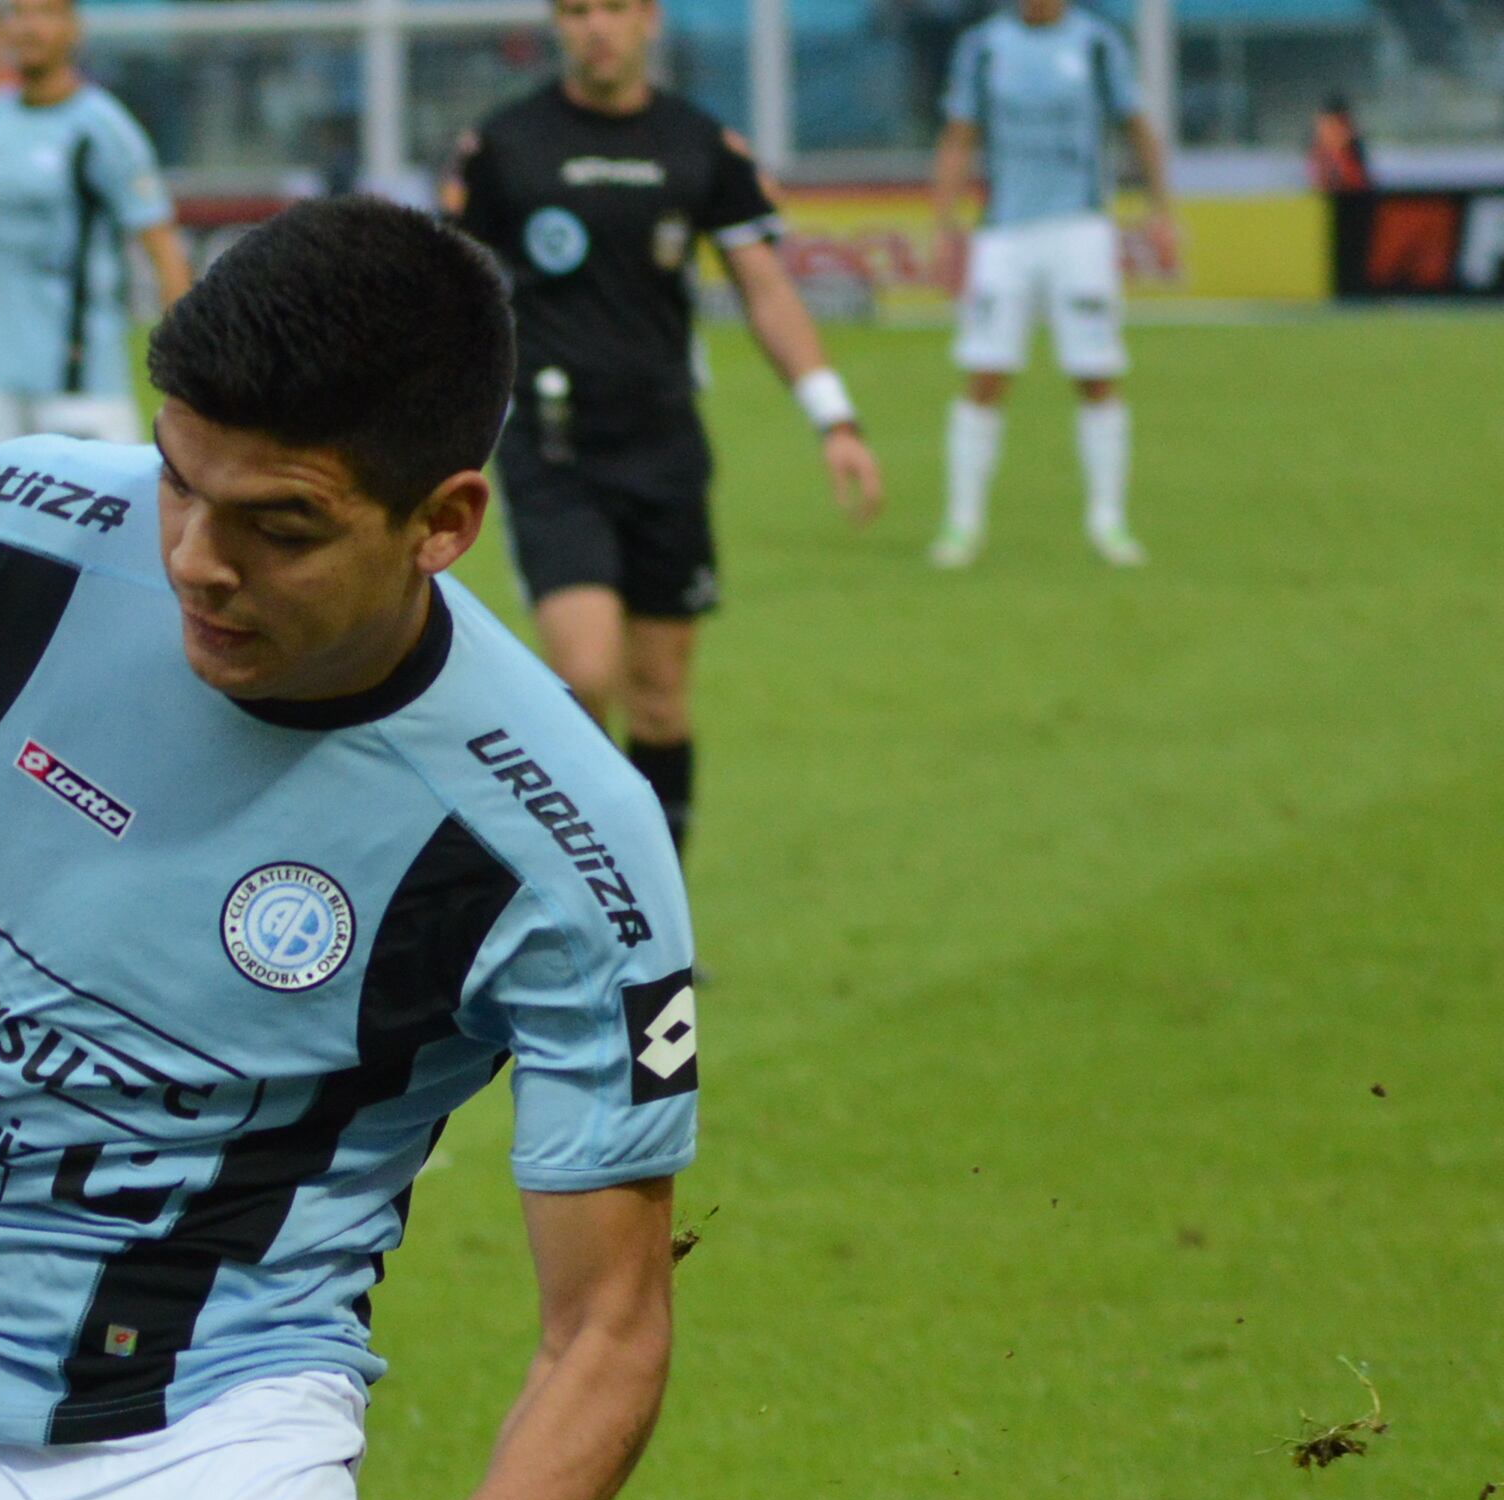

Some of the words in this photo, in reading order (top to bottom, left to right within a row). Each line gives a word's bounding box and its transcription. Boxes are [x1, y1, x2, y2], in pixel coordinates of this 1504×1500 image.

[46, 766, 125, 830] lotto
[229, 881, 257, 919] CLUB
[317, 894, 348, 973] BELGRANO
[231, 941, 300, 984] CORDOBA
